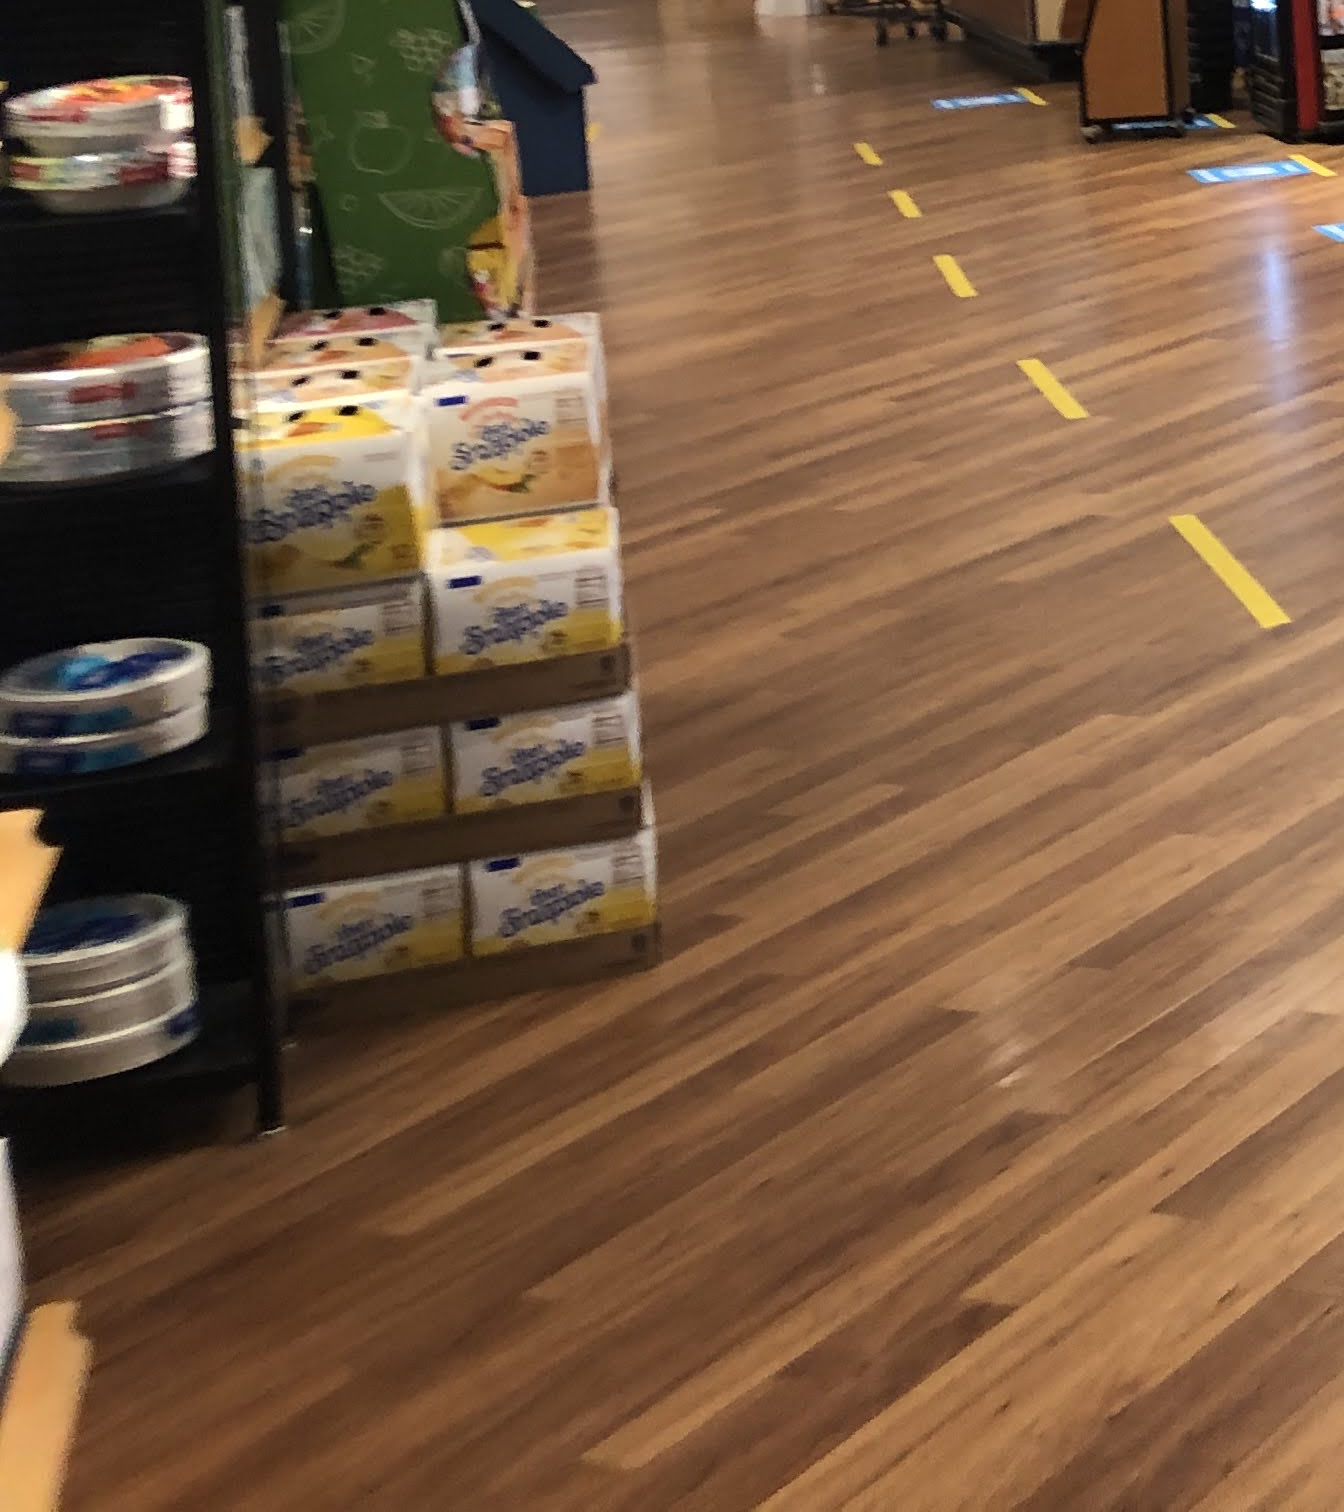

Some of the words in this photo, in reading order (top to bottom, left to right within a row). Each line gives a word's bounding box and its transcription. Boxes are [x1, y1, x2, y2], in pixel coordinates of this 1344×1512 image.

[449, 418, 551, 472] Snapple
[459, 599, 569, 655] Snapple
[479, 738, 585, 797] Snapple
[499, 879, 604, 938] Snapple
[302, 912, 412, 975] Snapple
